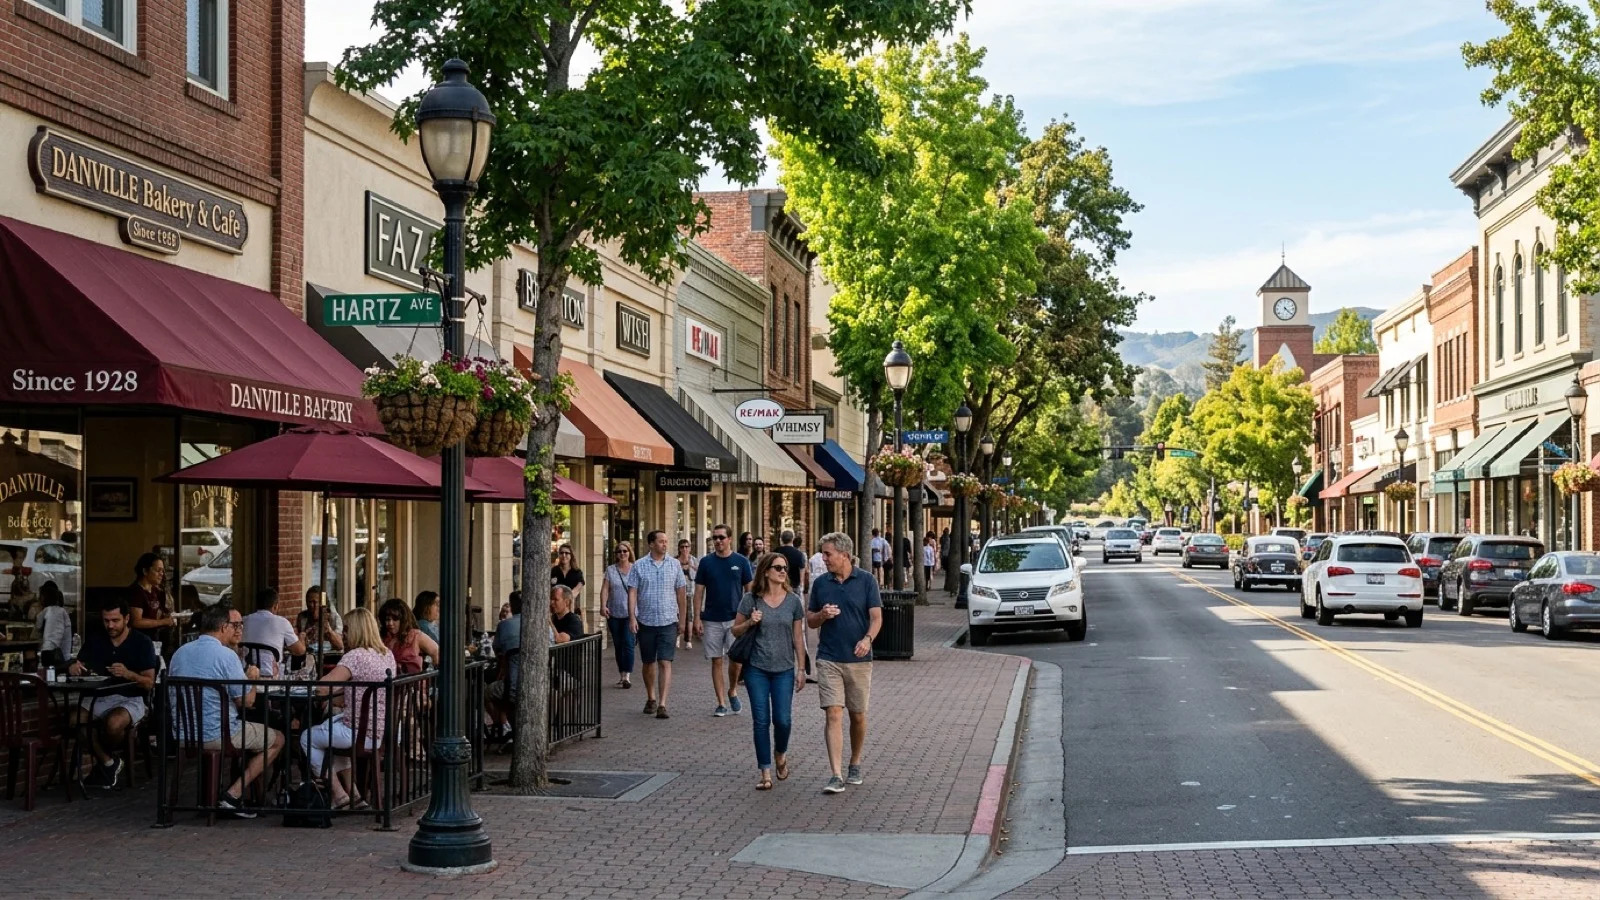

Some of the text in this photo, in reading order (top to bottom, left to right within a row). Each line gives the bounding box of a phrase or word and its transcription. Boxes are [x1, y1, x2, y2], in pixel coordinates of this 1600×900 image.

[52, 146, 241, 239] DANVILLE Bakery & Cafe
[377, 212, 423, 276] FAZ
[333, 298, 433, 321] HARTZ AVE
[621, 311, 649, 350] WISH
[12, 368, 138, 392] Since 1928
[230, 383, 301, 416] DANVILLE
[775, 422, 820, 433] WHIMSY
[0, 473, 65, 504] DANVILLE
